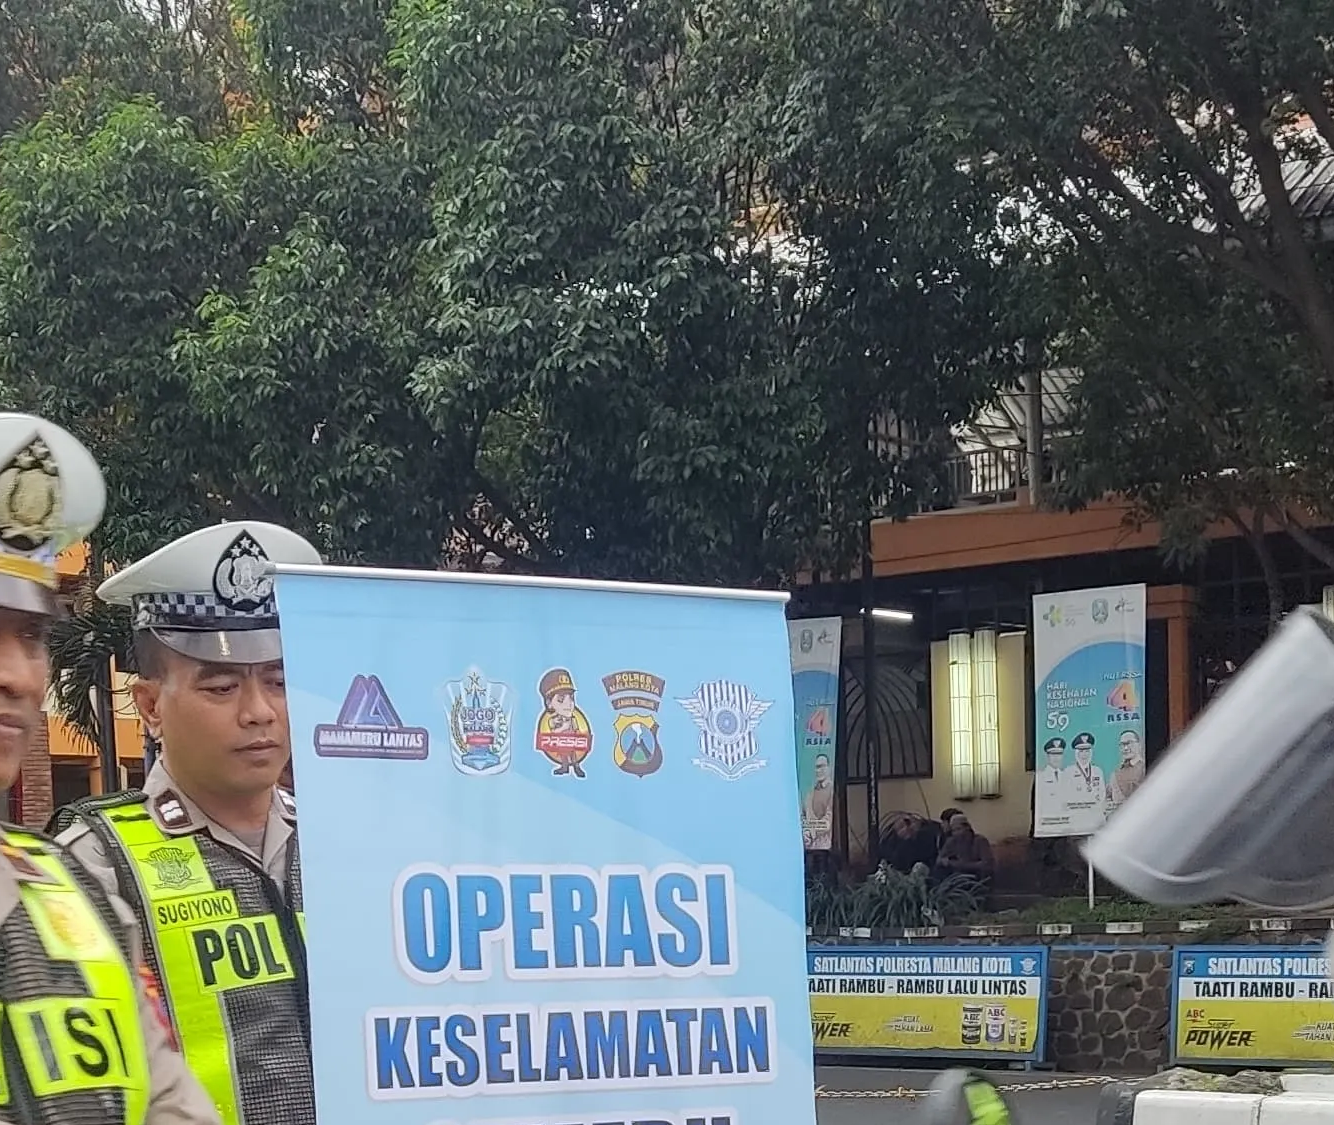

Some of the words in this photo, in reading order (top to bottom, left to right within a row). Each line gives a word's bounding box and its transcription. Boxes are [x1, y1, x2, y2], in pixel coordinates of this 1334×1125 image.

[461, 708, 495, 721] JOGO
[541, 736, 588, 748] PRESISI
[158, 895, 232, 925] SUGIYONO
[402, 872, 731, 973] OPERASI
[192, 922, 287, 987] POL
[814, 957, 873, 974] SATLANTAS
[876, 957, 931, 974] POLRESTA
[933, 957, 980, 973] MALANG
[982, 957, 1012, 973] KOTA
[1208, 957, 1280, 975] SATLANTAS
[808, 978, 836, 994] AATI
[839, 978, 885, 994] RAMBU
[896, 978, 943, 995] RAMBU
[947, 979, 977, 995] LALU
[981, 979, 1027, 996] LINTAS
[1193, 981, 1235, 998] TAATI
[1240, 981, 1295, 998] RAMBU
[1186, 1009, 1205, 1019] ABC
[374, 1006, 770, 1089] KESELAMATAN
[1185, 1030, 1257, 1050] POWER
